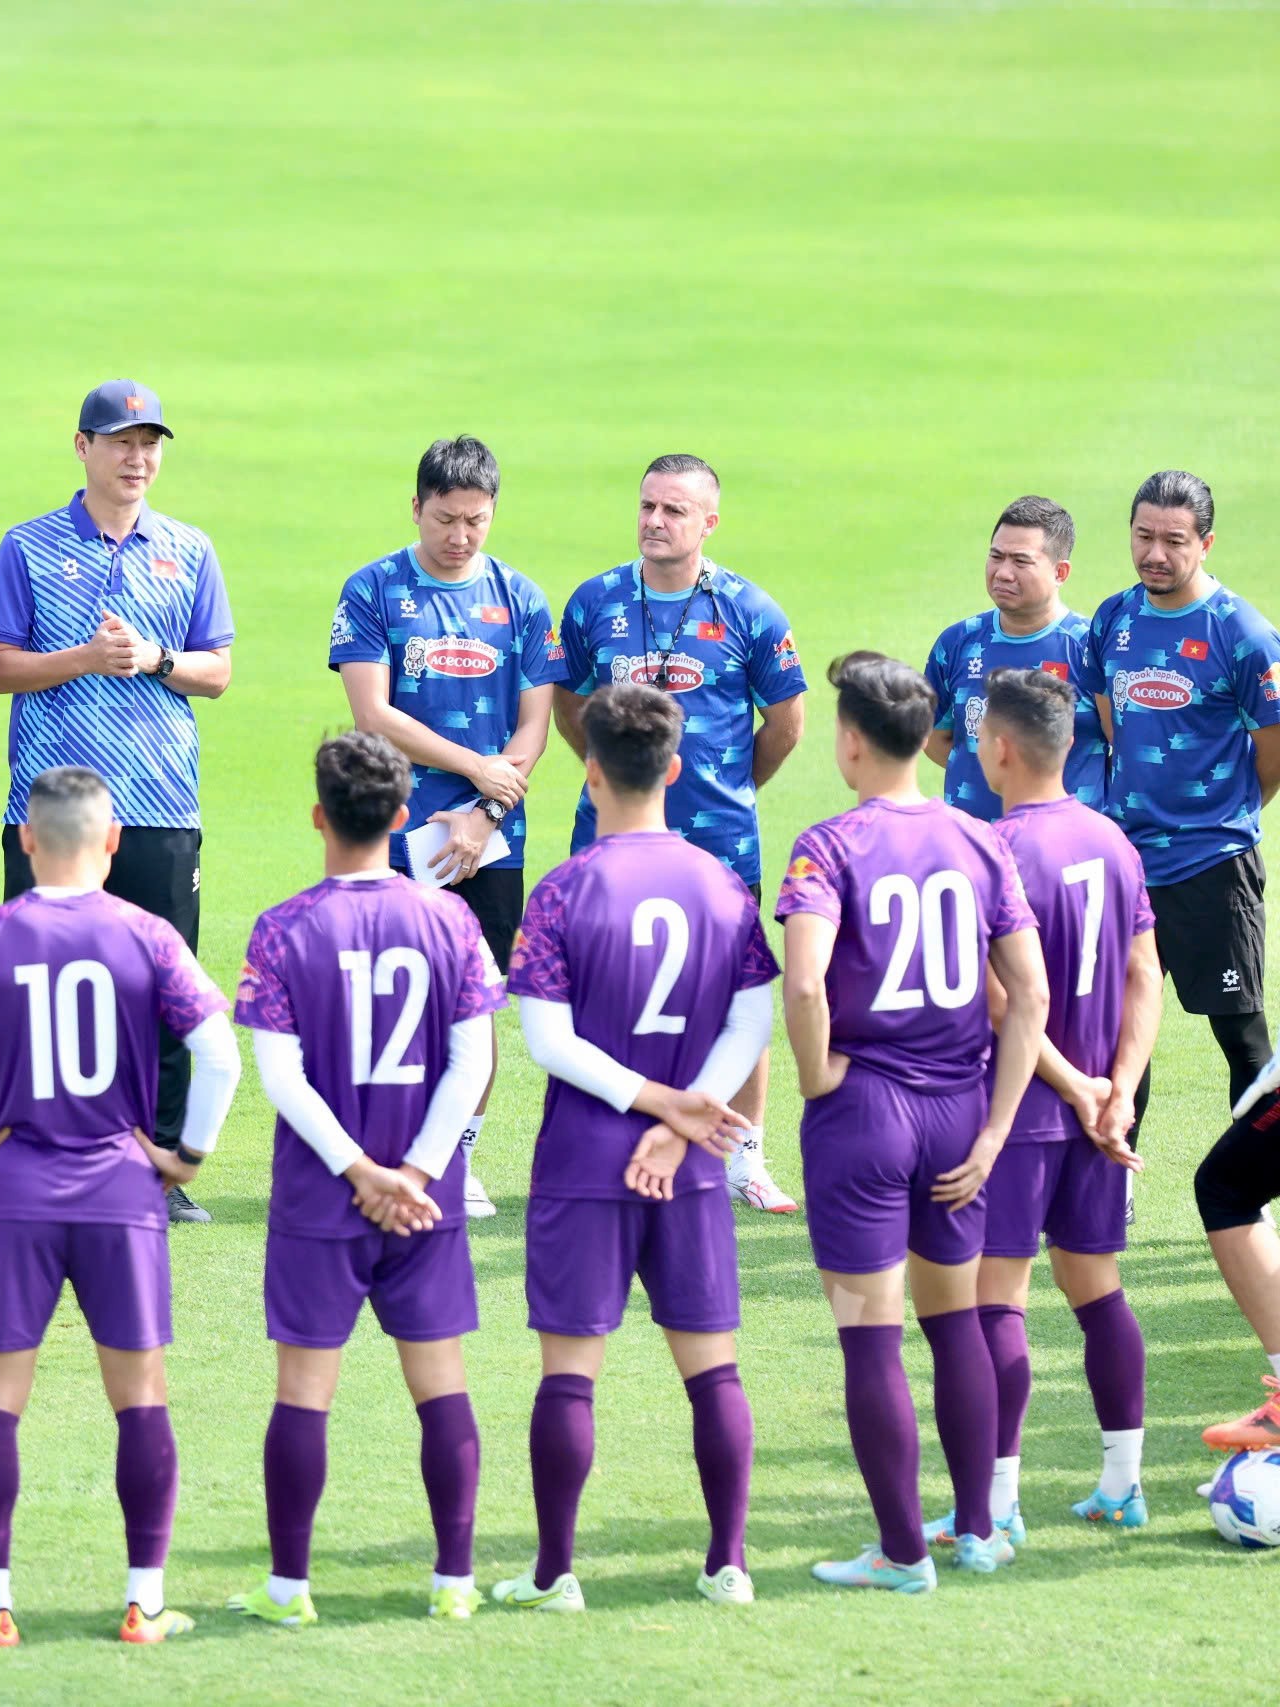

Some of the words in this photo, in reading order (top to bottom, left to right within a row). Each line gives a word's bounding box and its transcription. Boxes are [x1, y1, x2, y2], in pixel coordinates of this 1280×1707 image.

[657, 651, 703, 670] hppiness
[632, 897, 689, 1035] 2
[870, 870, 979, 1011] 20
[1062, 858, 1105, 997] 7
[13, 959, 117, 1100] 10
[338, 946, 430, 1086] 12
